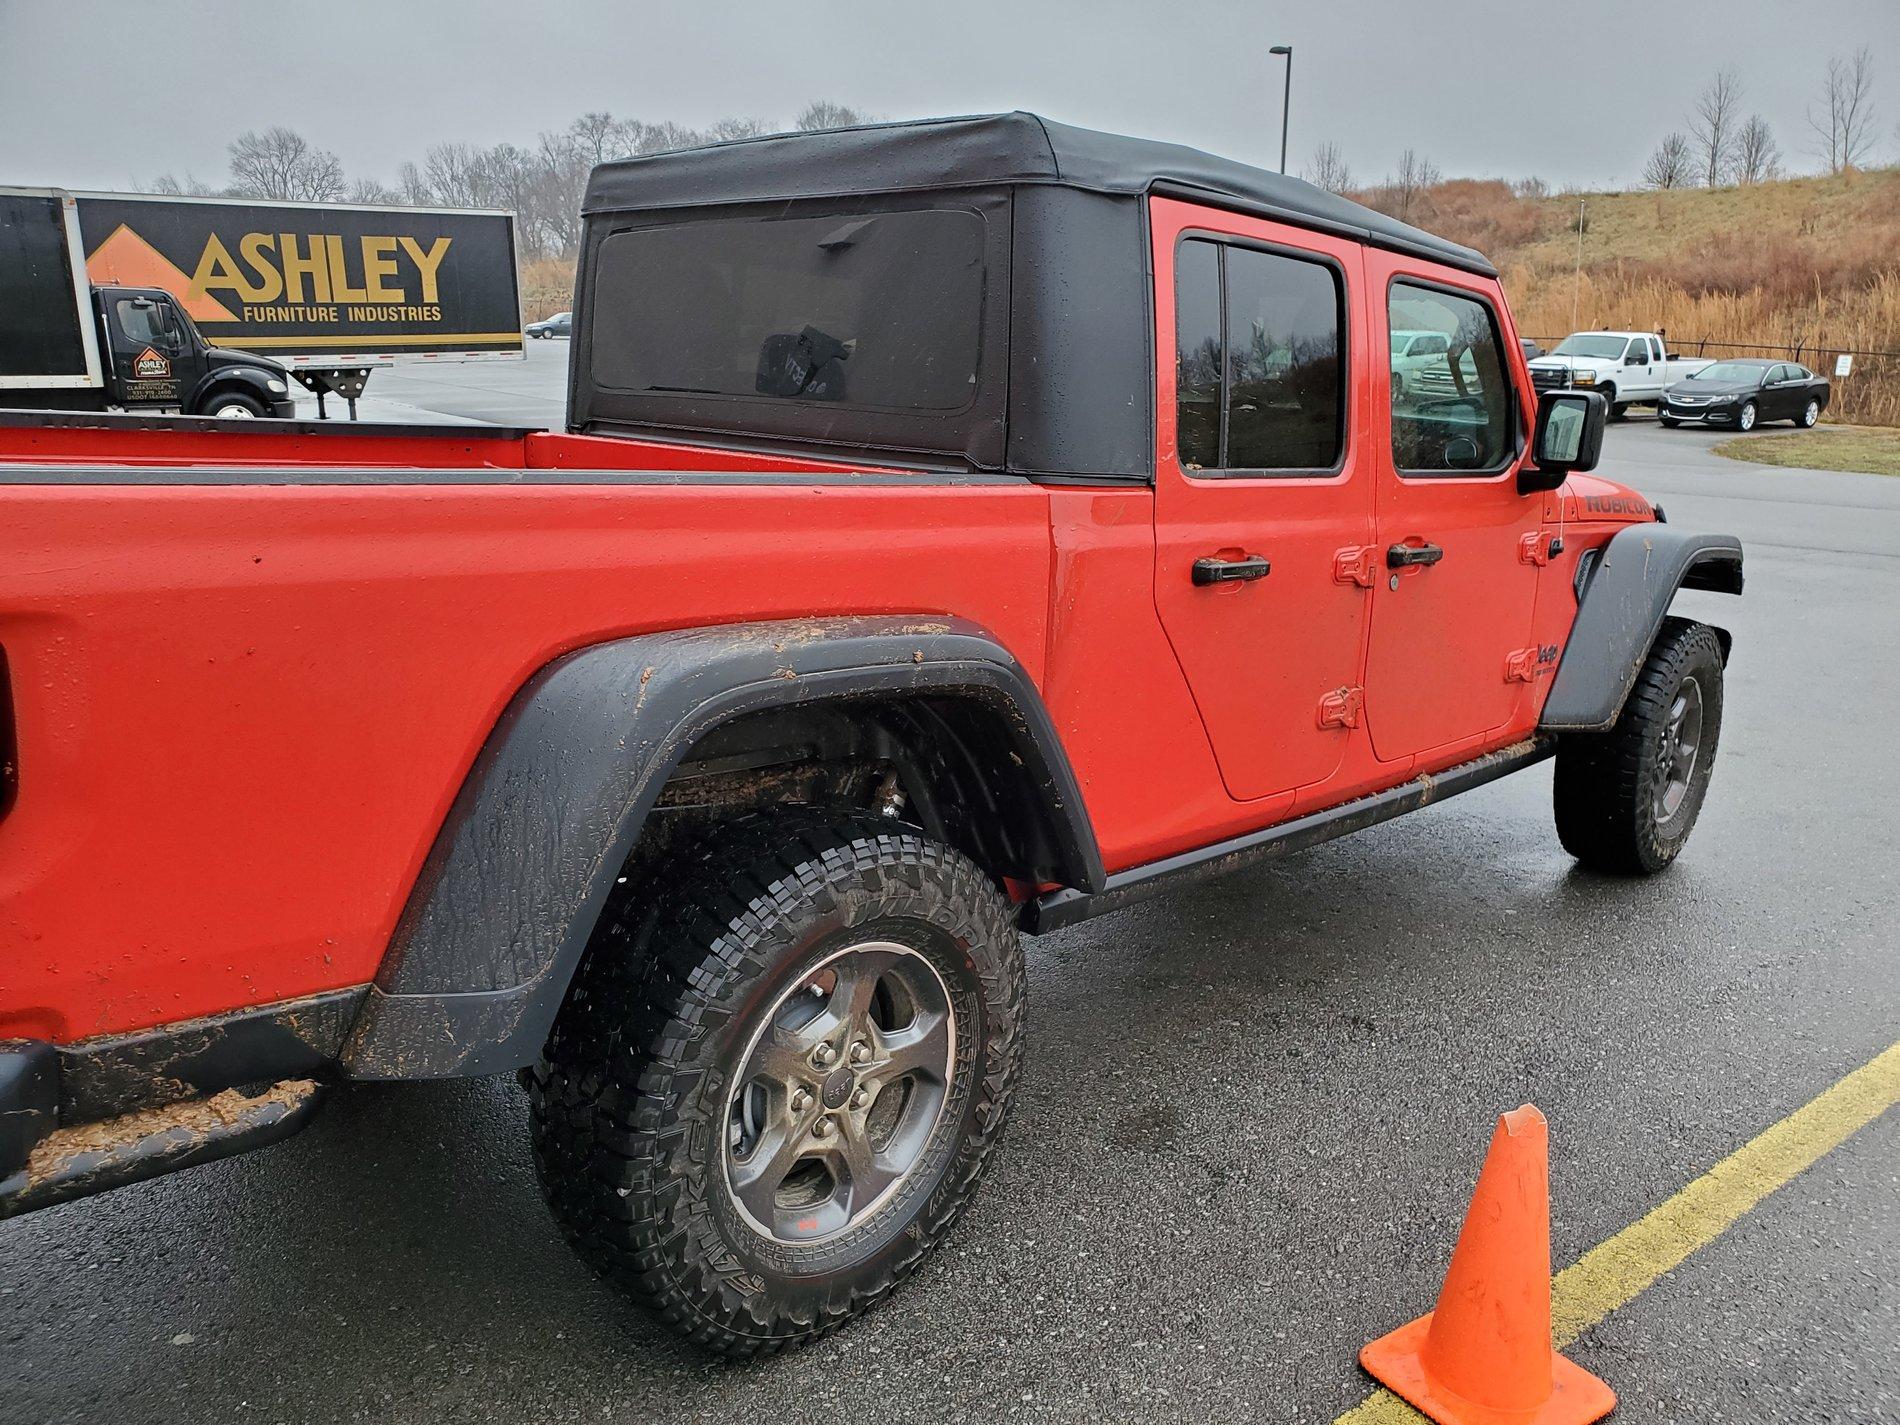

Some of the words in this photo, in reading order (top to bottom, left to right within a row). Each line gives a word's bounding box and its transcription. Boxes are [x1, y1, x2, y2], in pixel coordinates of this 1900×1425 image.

[187, 231, 453, 304] ASHLEY
[243, 306, 339, 322] FURNITURE
[348, 306, 442, 321] INDUSTRIES
[138, 360, 166, 369] ASHLEY
[1585, 495, 1652, 516] RUBICON
